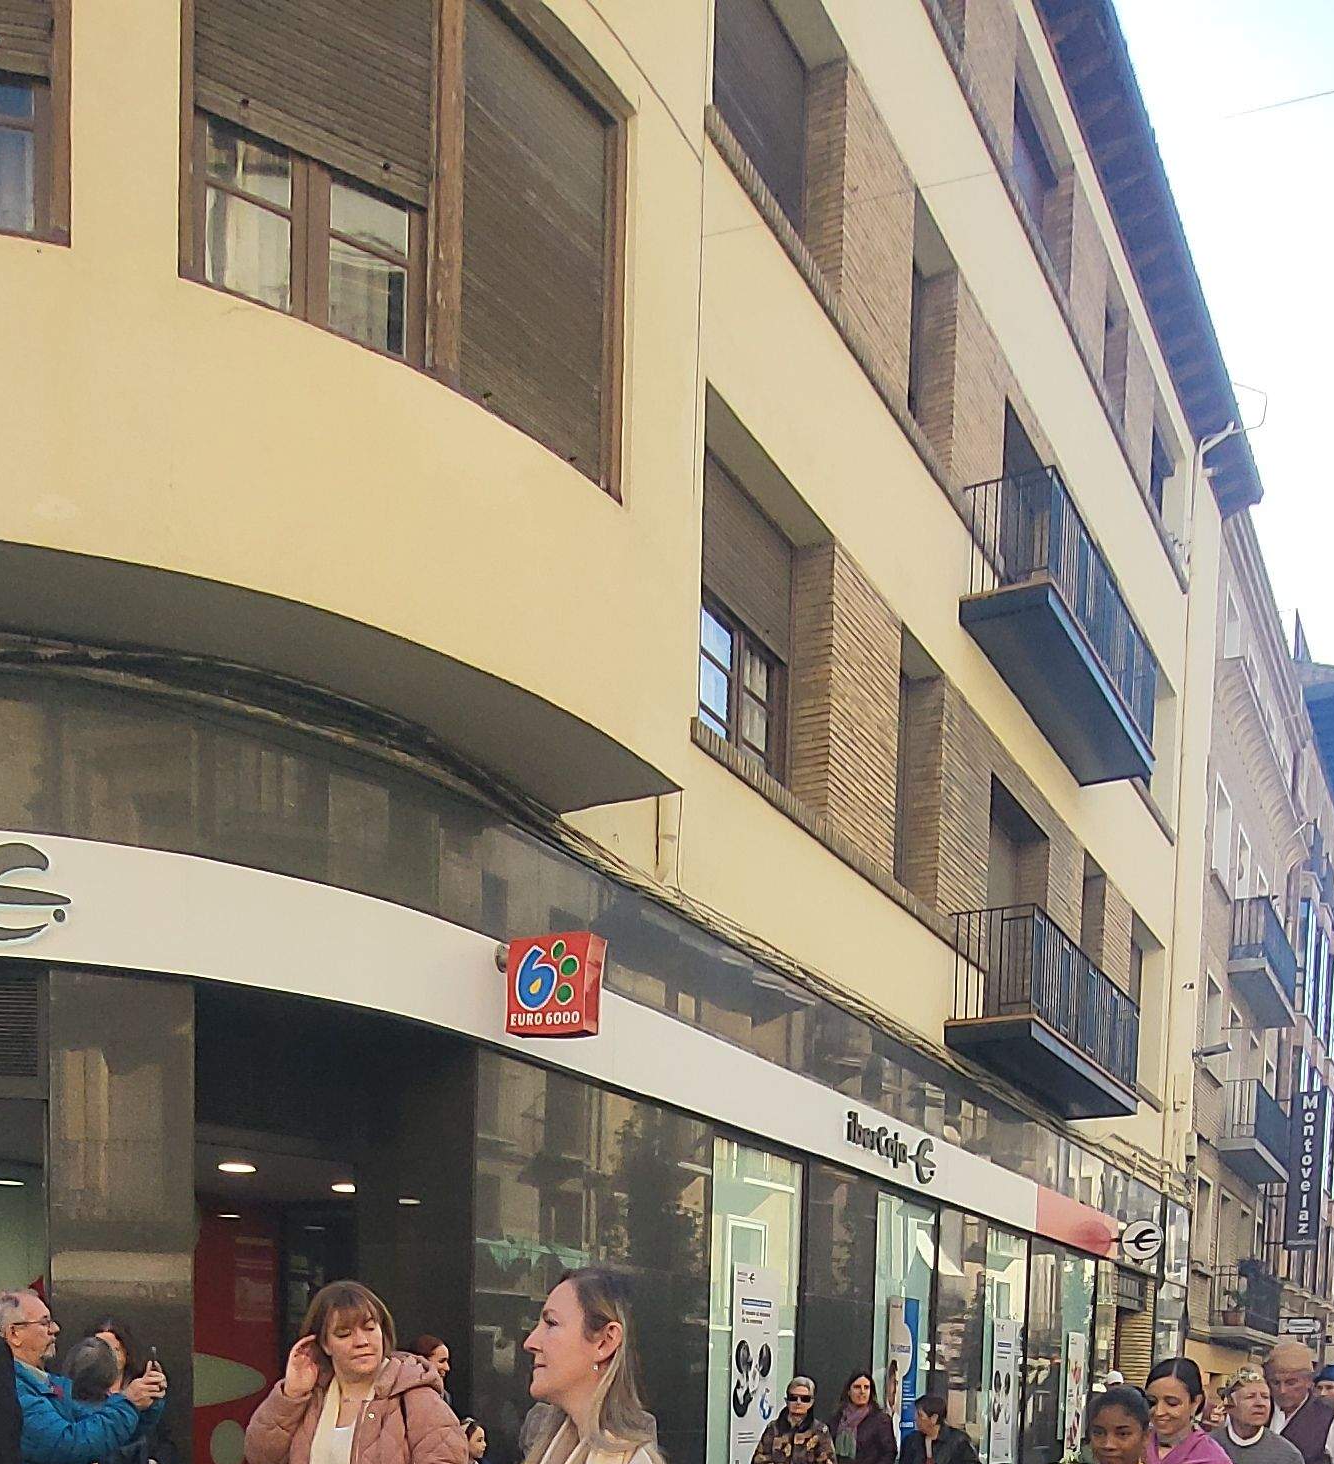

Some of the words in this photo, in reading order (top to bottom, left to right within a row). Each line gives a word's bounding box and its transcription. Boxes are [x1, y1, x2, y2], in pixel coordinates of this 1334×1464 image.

[510, 1012, 543, 1027] EURO
[545, 1010, 580, 1025] 6000
[847, 1110, 907, 1169] iberCaja
[1297, 1094, 1319, 1235] Montovelaz
